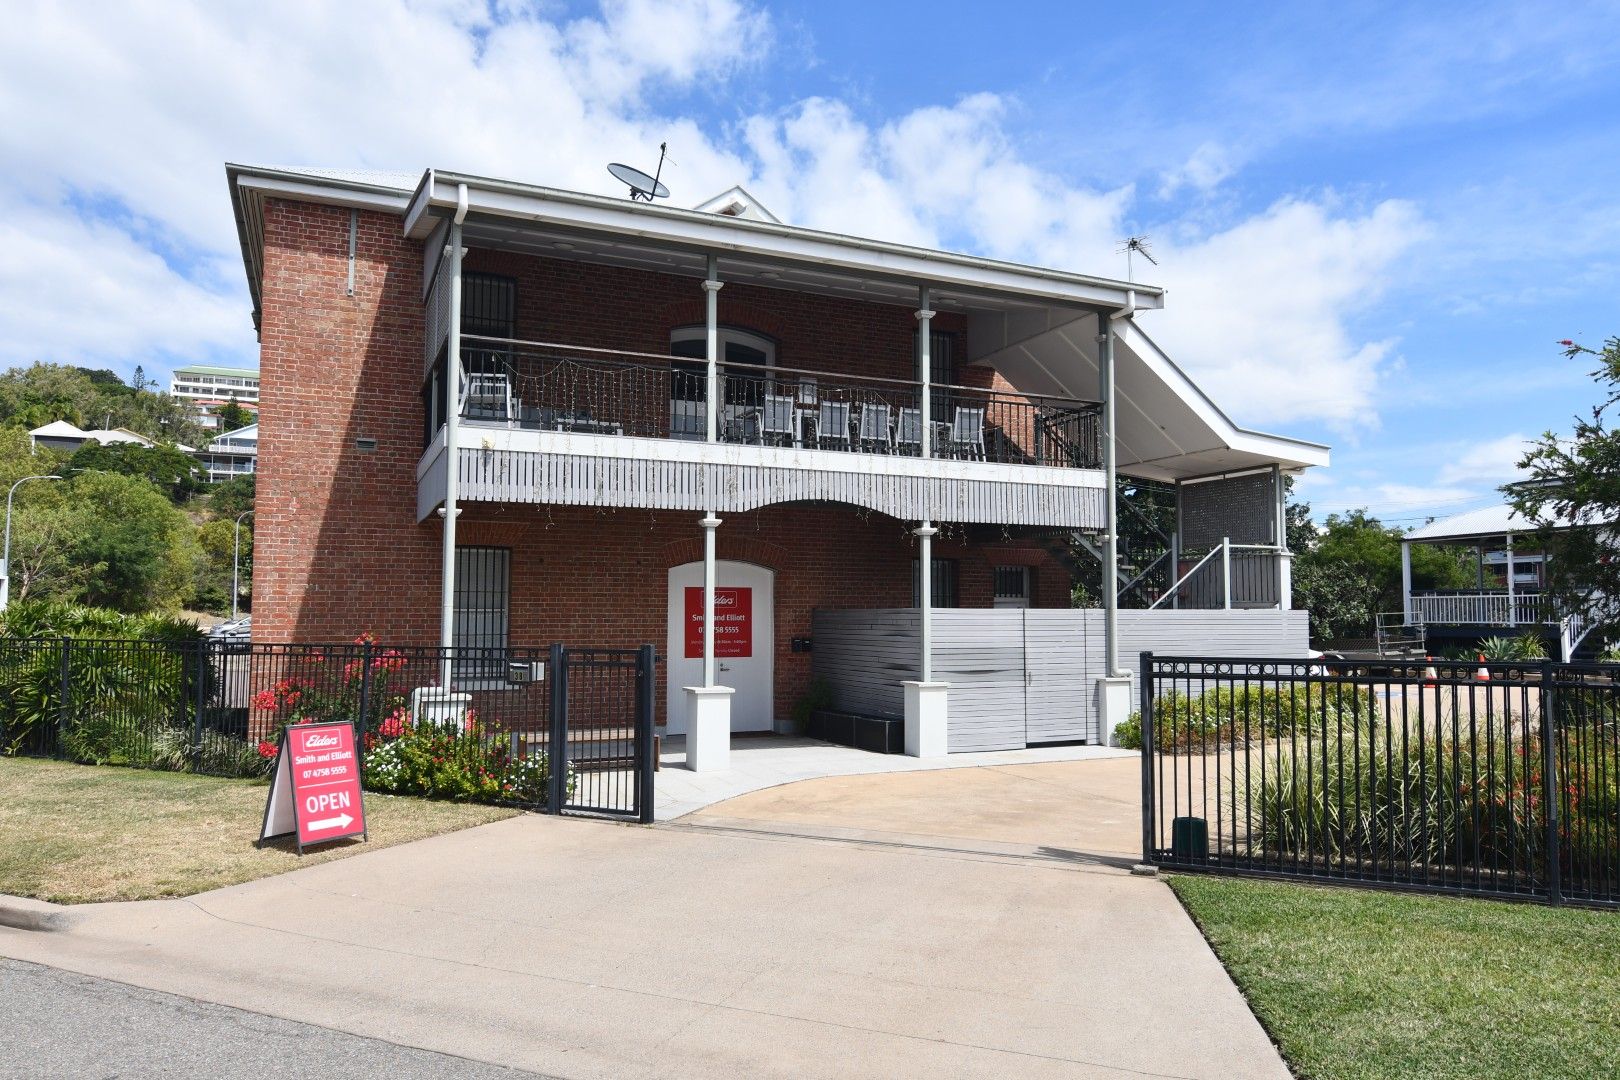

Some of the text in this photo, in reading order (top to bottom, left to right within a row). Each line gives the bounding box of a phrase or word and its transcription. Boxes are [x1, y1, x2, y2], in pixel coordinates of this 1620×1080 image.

[692, 614, 705, 622] Smi
[306, 735, 338, 747] Elders
[295, 751, 352, 765] Smith and Elliott
[303, 765, 347, 779] 07 4758 5555
[306, 790, 351, 814] OPEN
